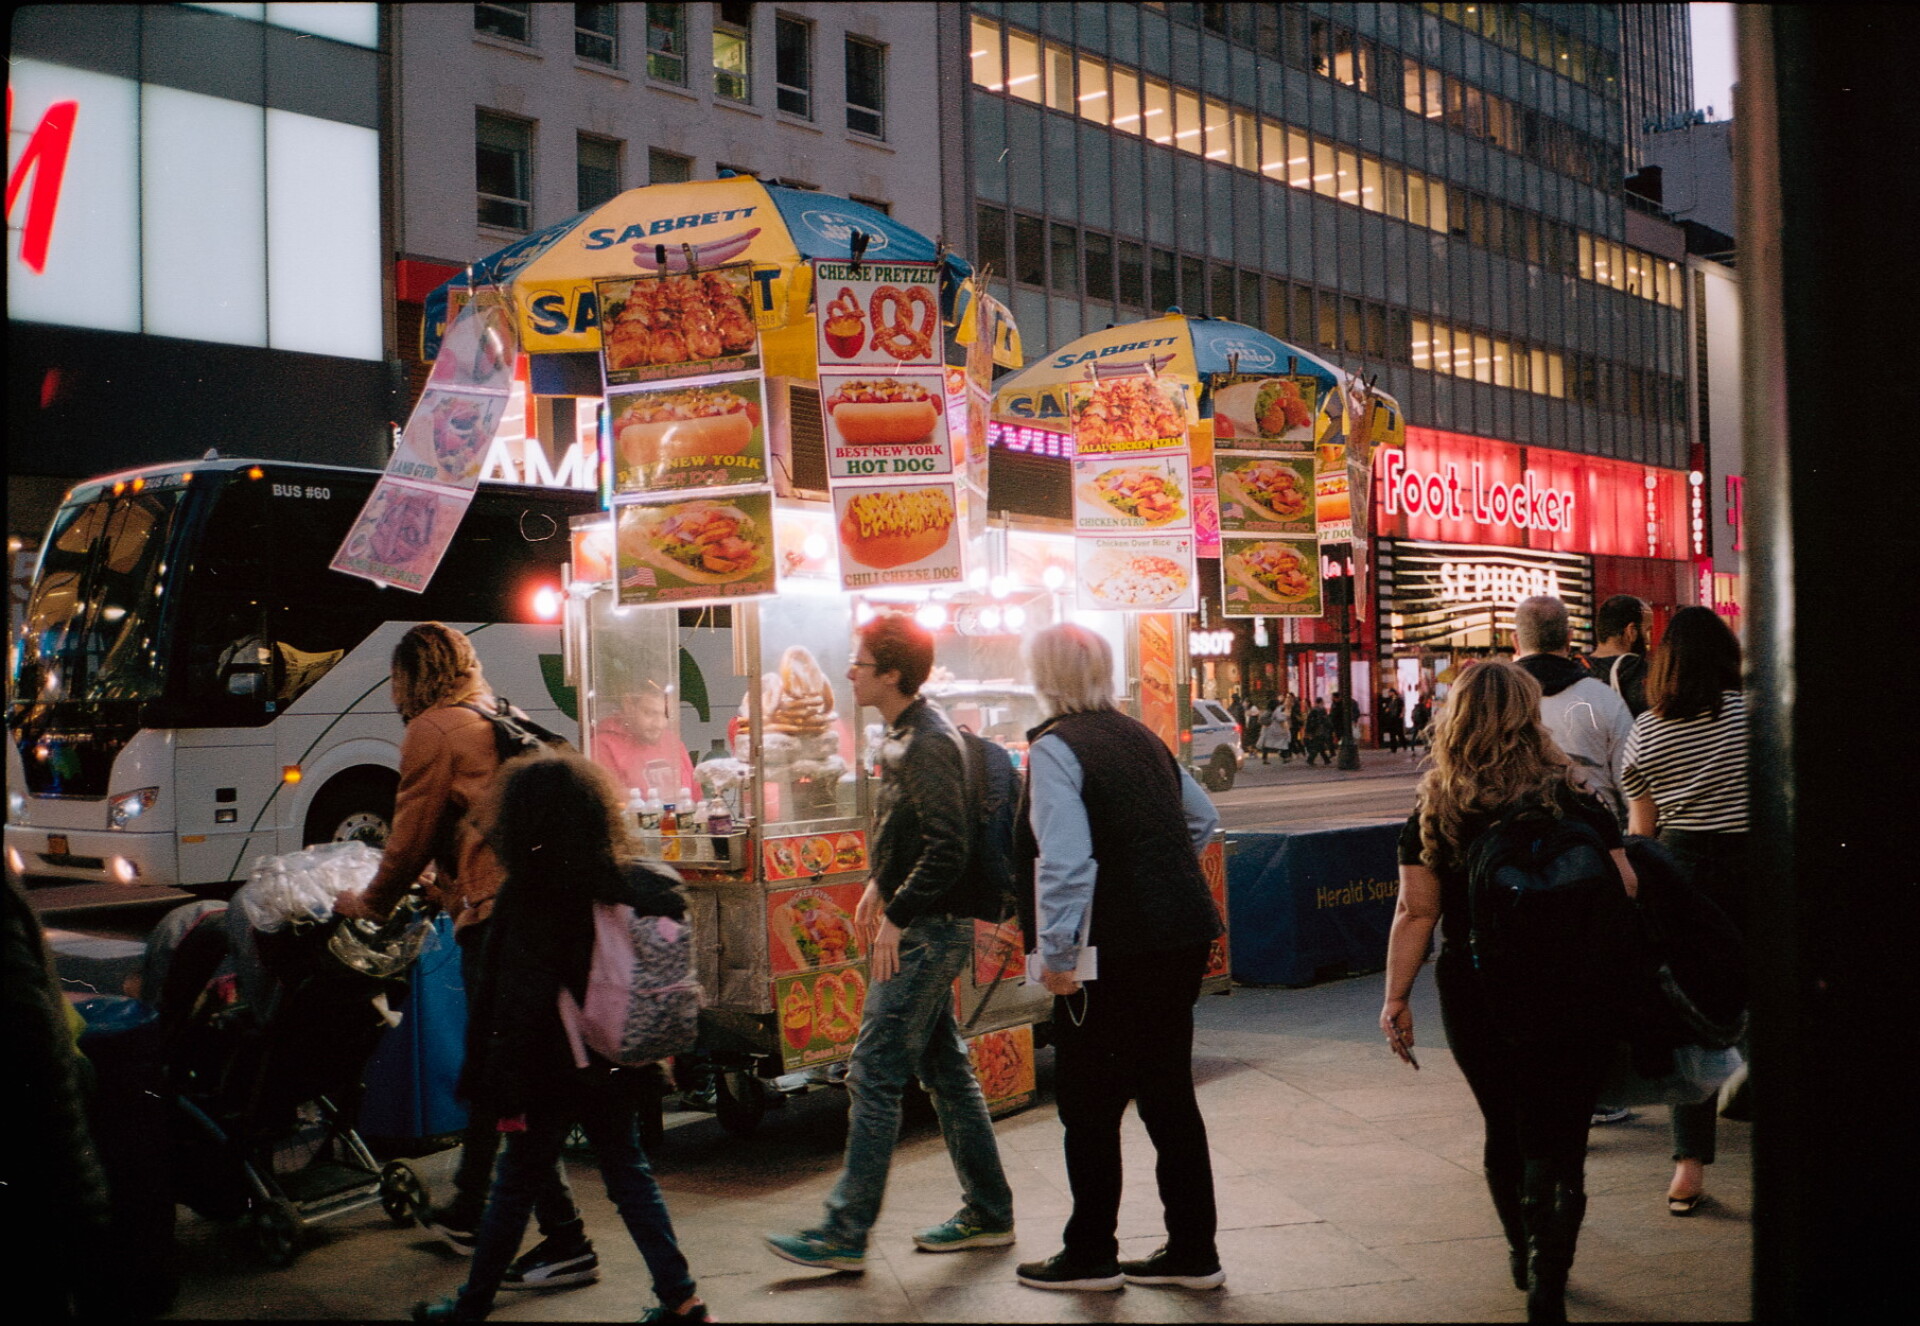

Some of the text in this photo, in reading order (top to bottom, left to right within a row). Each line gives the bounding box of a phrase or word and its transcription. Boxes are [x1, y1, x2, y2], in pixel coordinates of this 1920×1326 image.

[584, 206, 758, 251] SABRETT
[818, 264, 937, 284] CHEESE PRETZEL
[1052, 336, 1179, 369] SABRETT
[835, 445, 943, 458] BEST NEW YORK
[669, 454, 706, 469] NEW
[711, 454, 762, 470] YORK
[846, 458, 935, 474] HOT DOG
[272, 483, 331, 500] BUS #60
[1383, 449, 1462, 521] Foot
[1472, 462, 1574, 532] Locker
[1079, 517, 1146, 527] CHICKEN GYRO
[1131, 539, 1150, 548] Over
[844, 566, 960, 587] CHILI CHEESE DOG
[1440, 562, 1559, 601] SEPHORA
[1189, 631, 1235, 656] SSOT
[1316, 878, 1400, 910] Herald Squa
